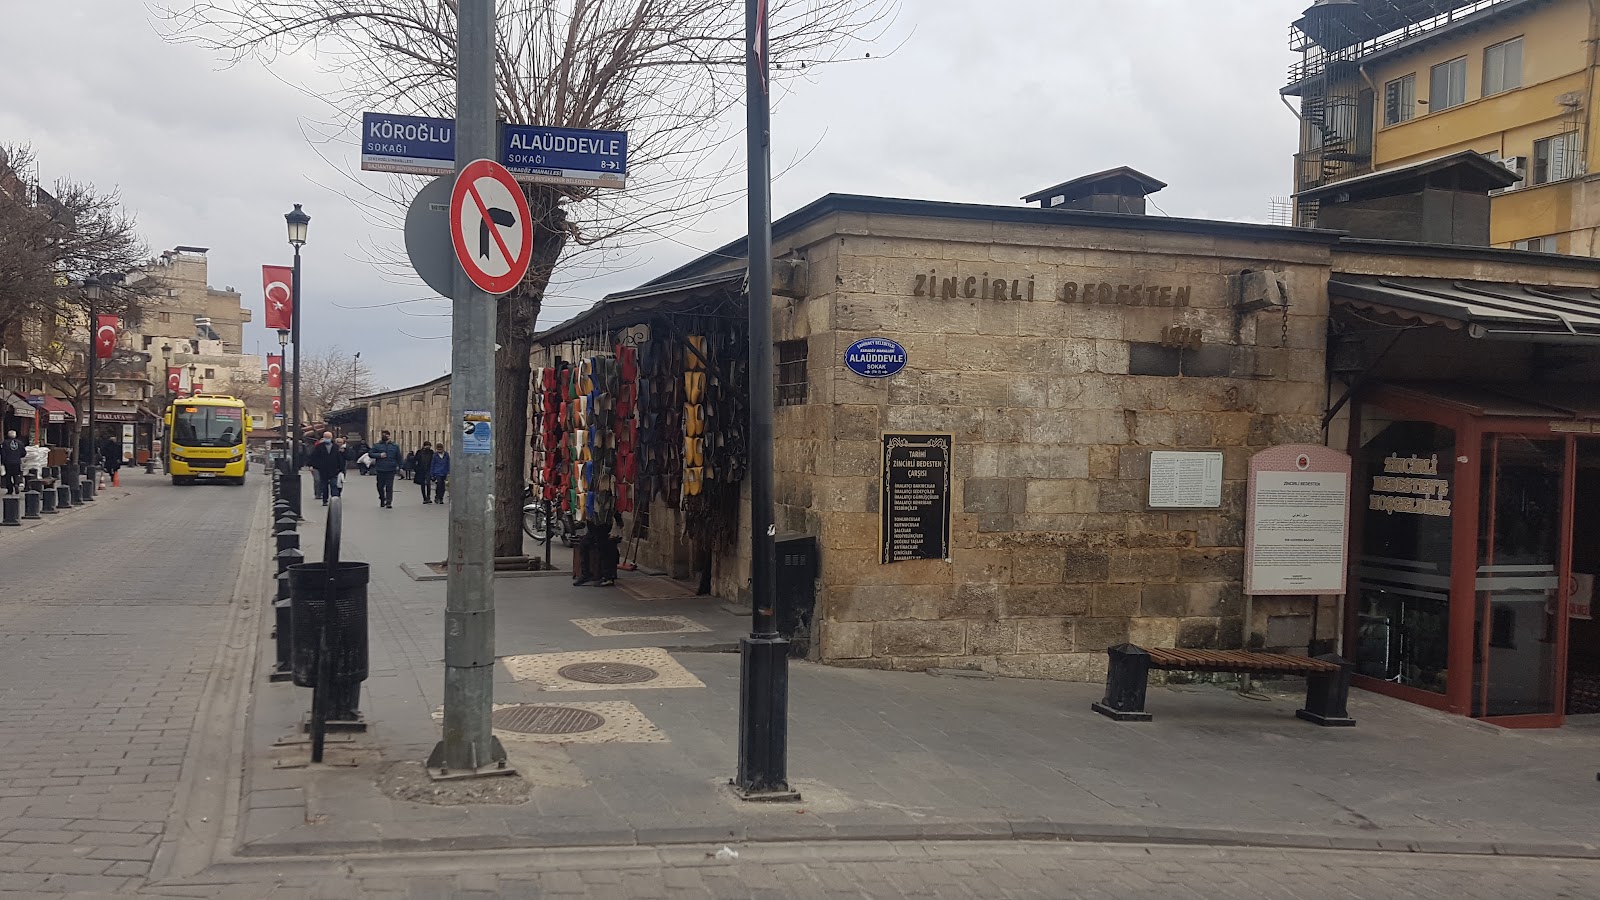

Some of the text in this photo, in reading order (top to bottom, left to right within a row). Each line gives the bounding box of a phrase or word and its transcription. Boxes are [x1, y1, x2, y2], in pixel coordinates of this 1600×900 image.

[370, 120, 450, 143] KÖROĞLU
[368, 143, 406, 153] SOKAĞI
[510, 133, 619, 156] ALAÜDDEVLE
[508, 154, 546, 164] SOKAĞI
[616, 161, 620, 170] 1
[913, 268, 1191, 307] ZİNCİRLİ BEDESTEN
[849, 353, 903, 362] ALAÜDDEVLE
[909, 450, 926, 458] TARİHİ
[893, 459, 915, 467] ZİNCİRLİ
[908, 470, 927, 478] ÇARŞISI
